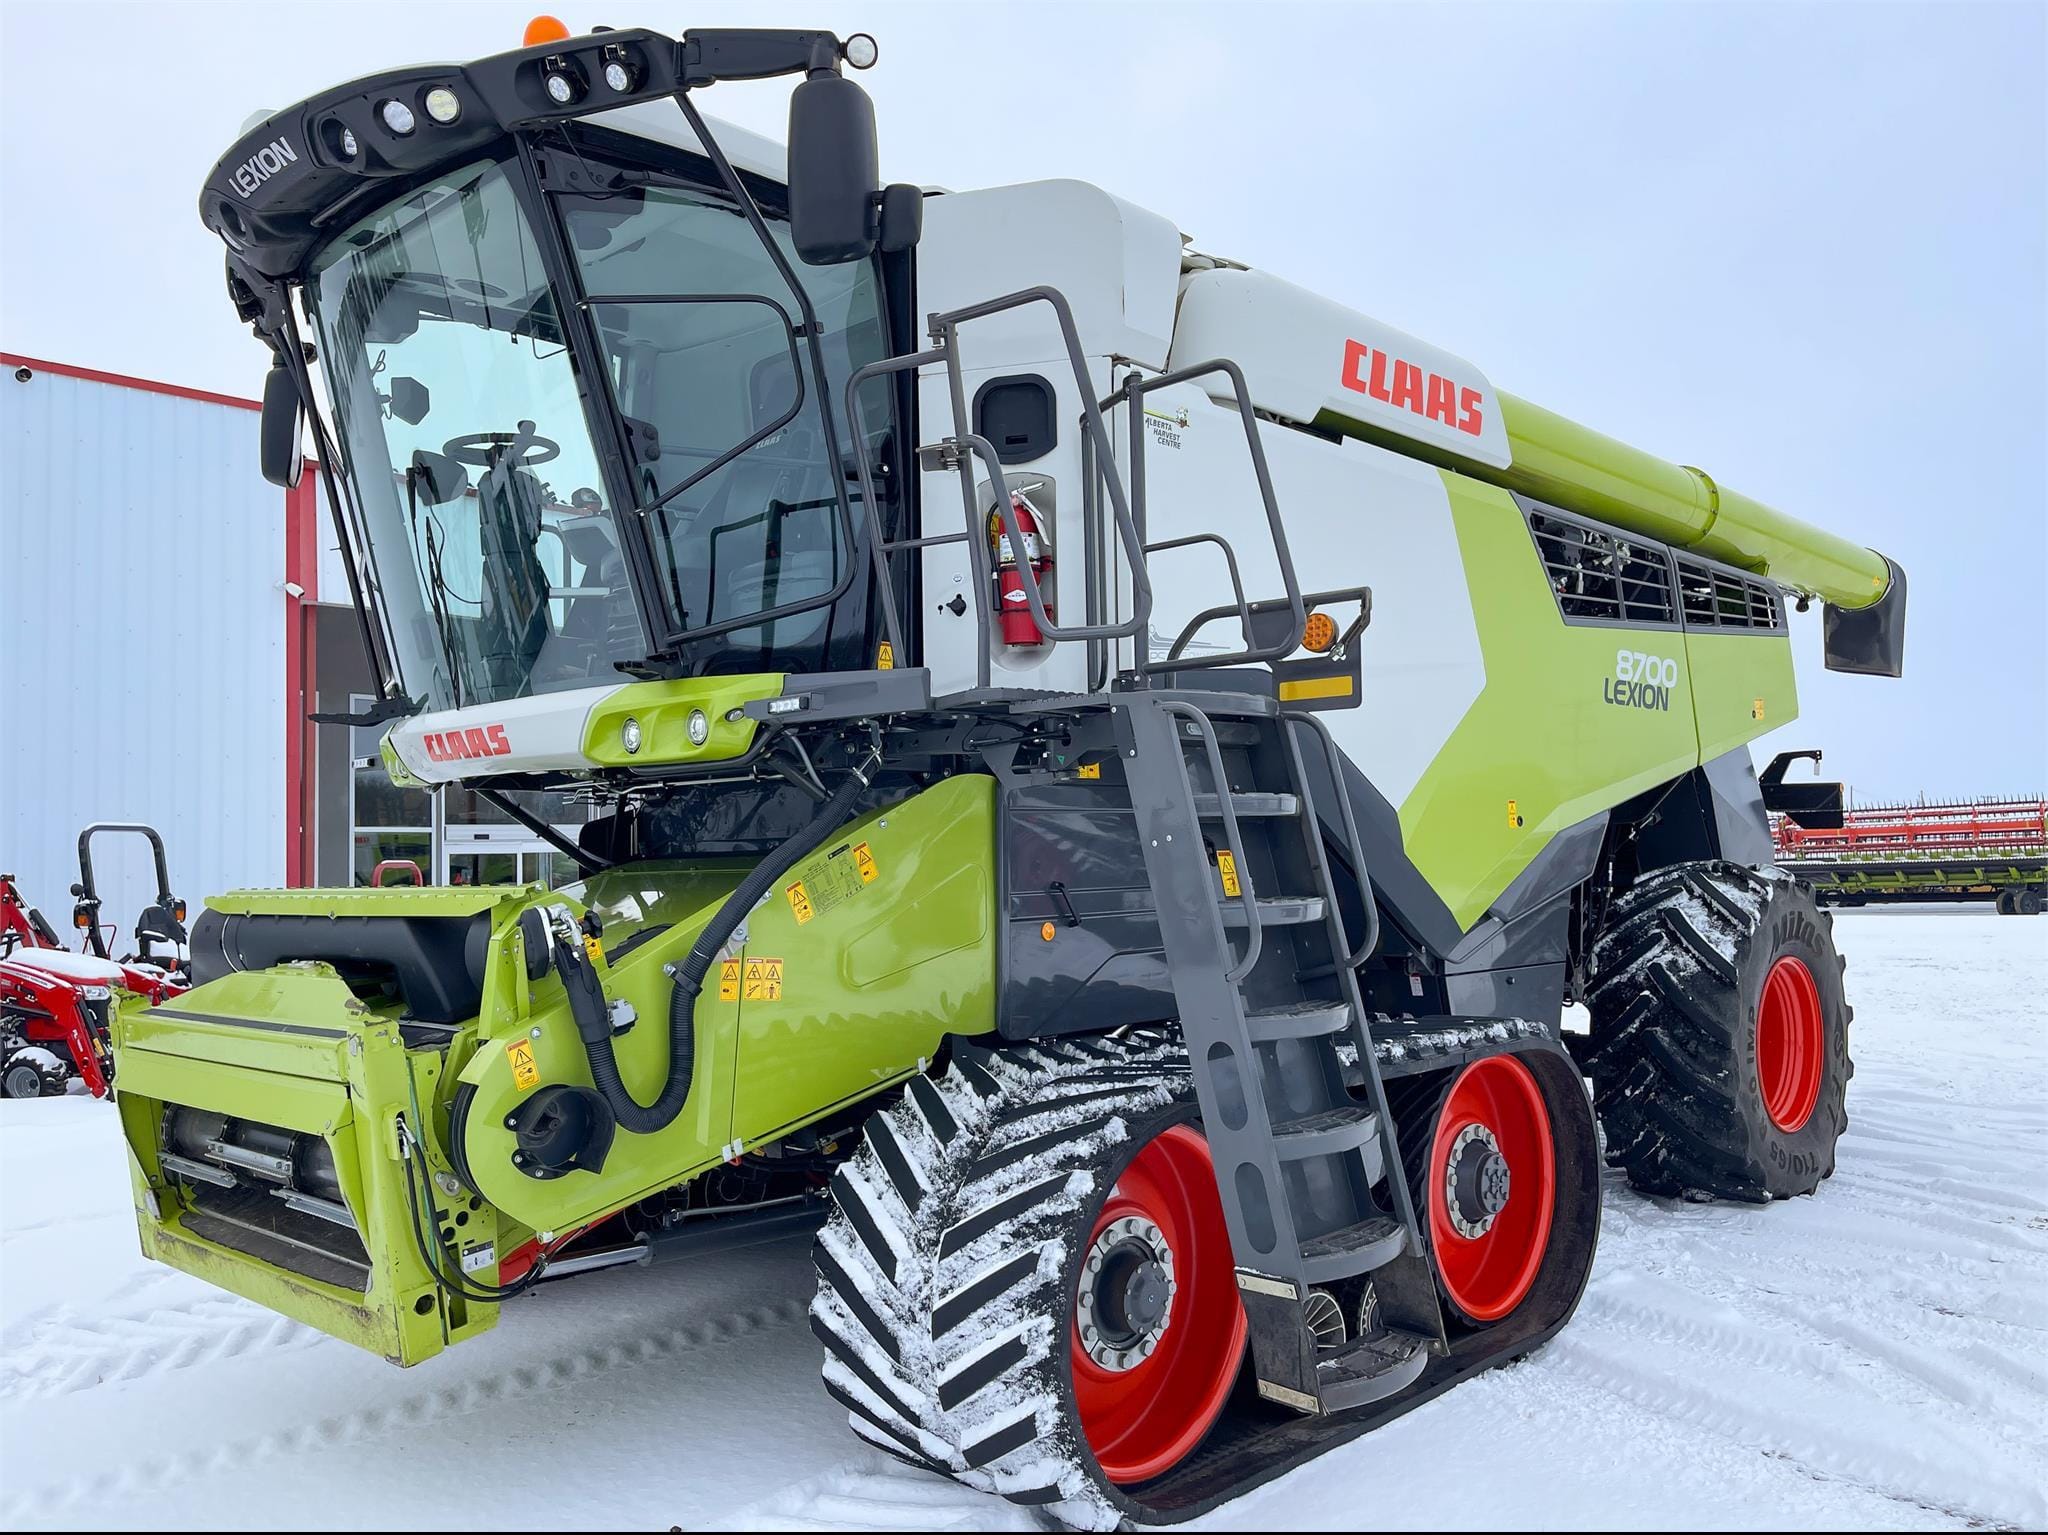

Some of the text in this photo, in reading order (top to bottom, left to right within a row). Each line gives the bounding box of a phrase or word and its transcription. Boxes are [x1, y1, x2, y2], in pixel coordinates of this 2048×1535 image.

[228, 136, 298, 199] LEXION
[1340, 337, 1483, 437] CLAAS
[1145, 417, 1173, 431] ALBERTA
[1153, 427, 1181, 443] HARVEST
[1157, 436, 1181, 450] CENTRE
[1616, 649, 1678, 688] 8700
[1604, 677, 1669, 711] LEXION
[423, 724, 511, 762] CLAAS
[1769, 910, 1825, 958] Mitas
[1769, 1140, 1820, 1176] 710/65
